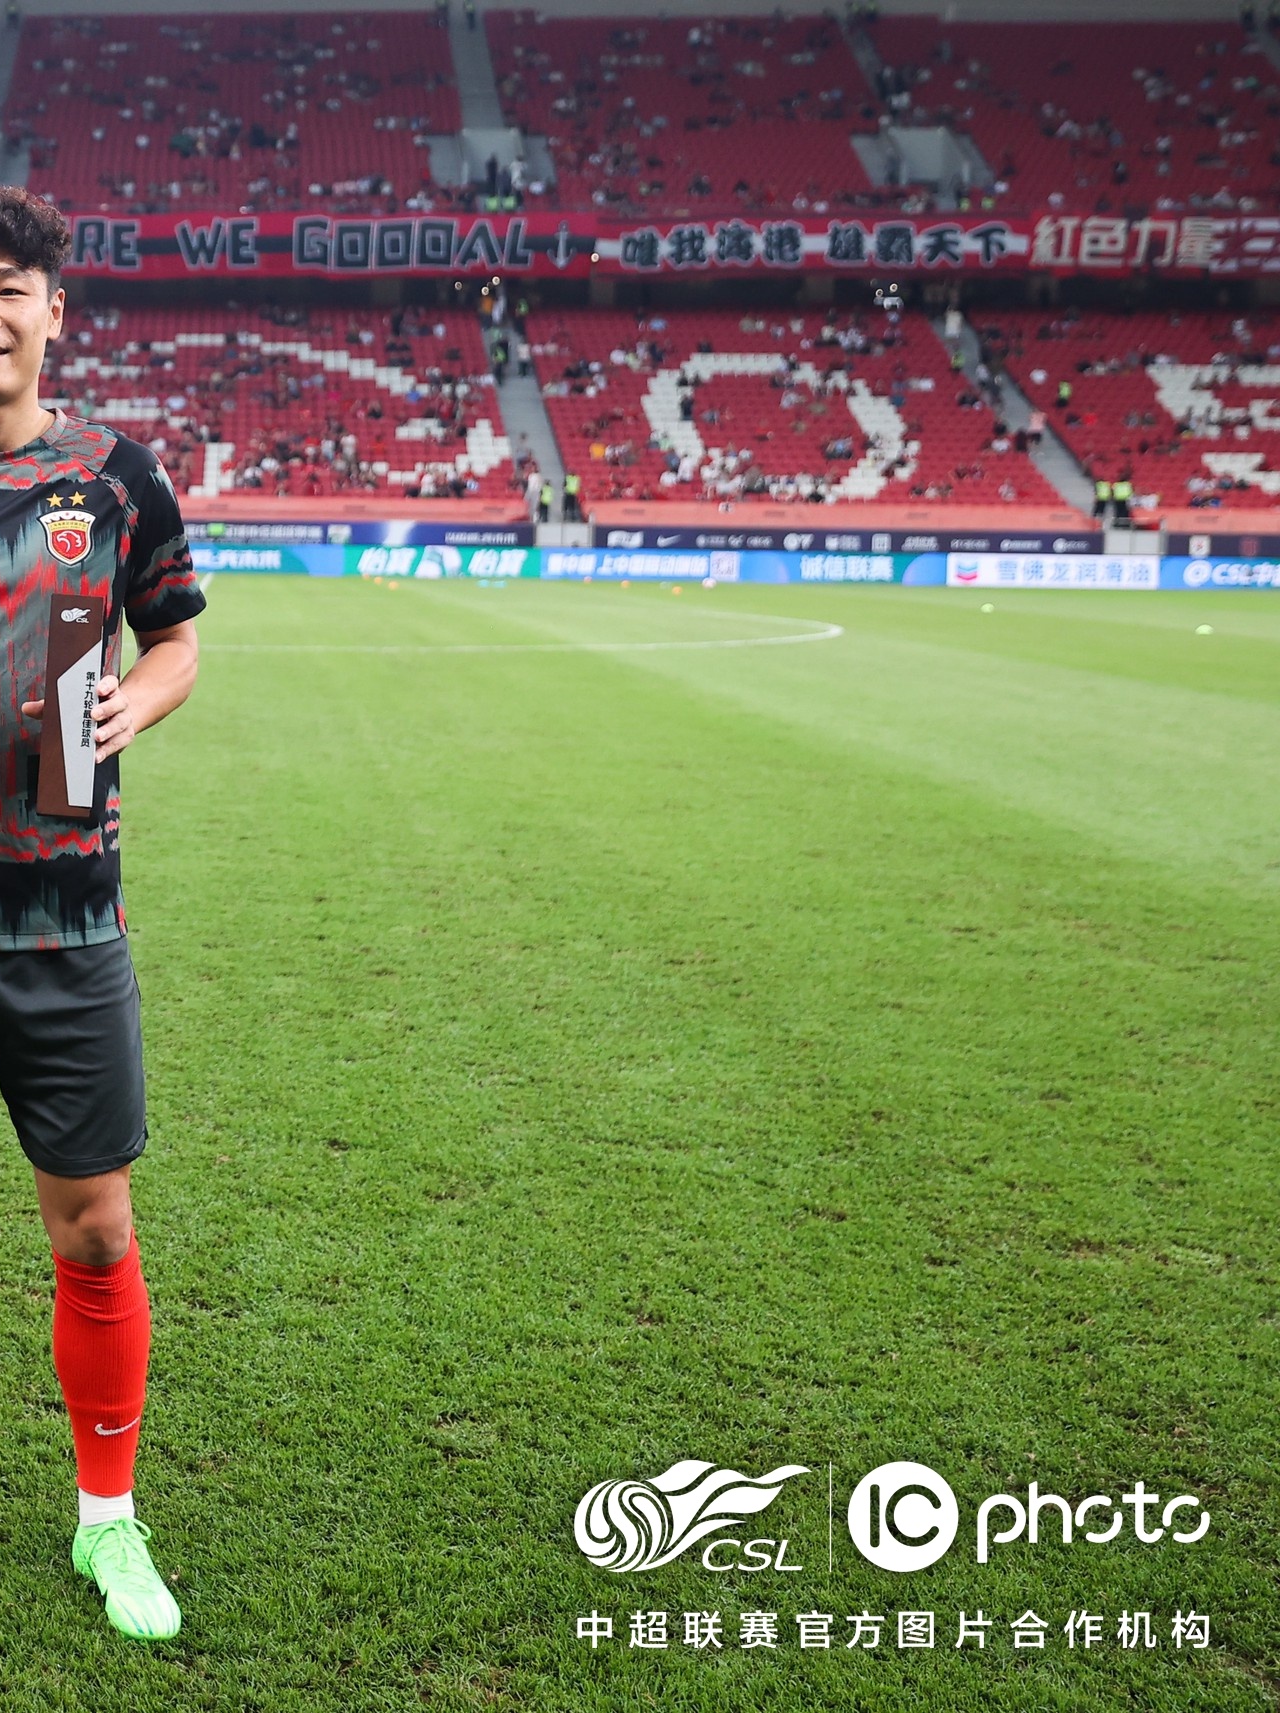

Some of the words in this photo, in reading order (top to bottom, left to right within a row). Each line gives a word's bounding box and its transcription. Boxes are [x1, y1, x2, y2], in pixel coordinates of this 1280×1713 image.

[64, 215, 142, 272] RE
[175, 215, 259, 271] WE
[292, 214, 535, 273] GOOOAL
[997, 559, 1151, 583] 雪佛龙润滑油
[80, 671, 96, 748] 第十九轮最佳球员
